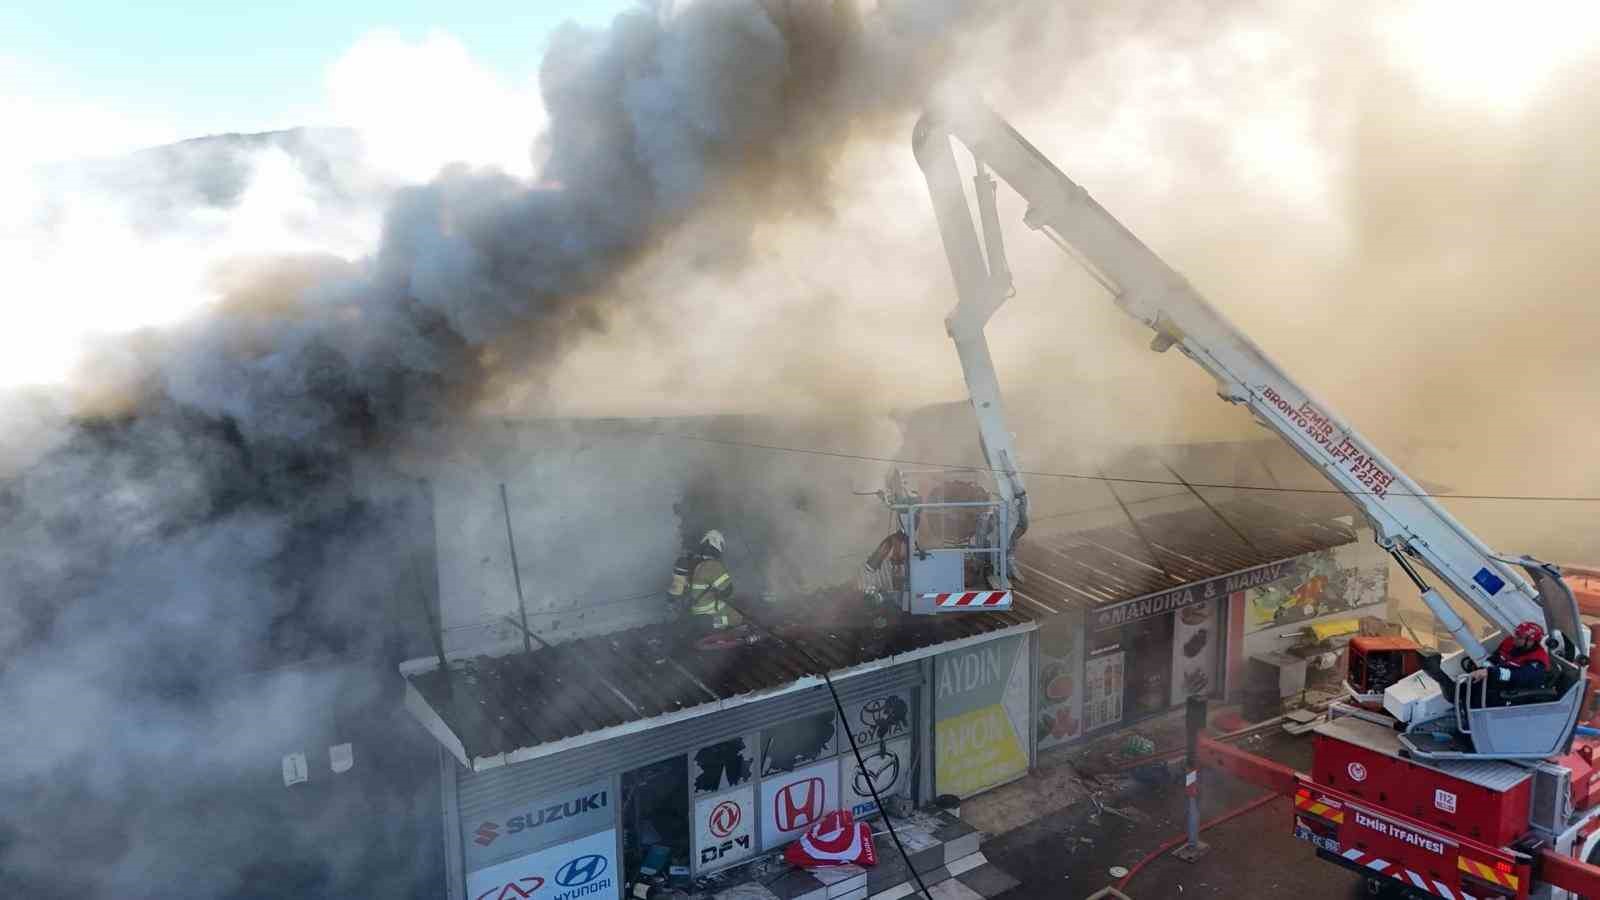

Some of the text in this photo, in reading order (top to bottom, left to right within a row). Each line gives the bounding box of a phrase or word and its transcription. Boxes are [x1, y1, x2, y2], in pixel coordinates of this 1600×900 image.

[1263, 388, 1306, 428] BRONTO
[1306, 425, 1349, 464] SKYLIFT
[1350, 464, 1374, 488] F22
[1299, 401, 1397, 488] İZMİR İTFAİYESİ
[1111, 564, 1281, 624] MANDIRA & MANAV
[938, 645, 1001, 699] AYDIN
[852, 720, 904, 744] TOYTA
[506, 791, 607, 835] SUZUKI
[1355, 812, 1444, 855] İZMİR İTFAİYESİ
[701, 834, 749, 863] DFM
[553, 878, 611, 900] HYUNDAI
